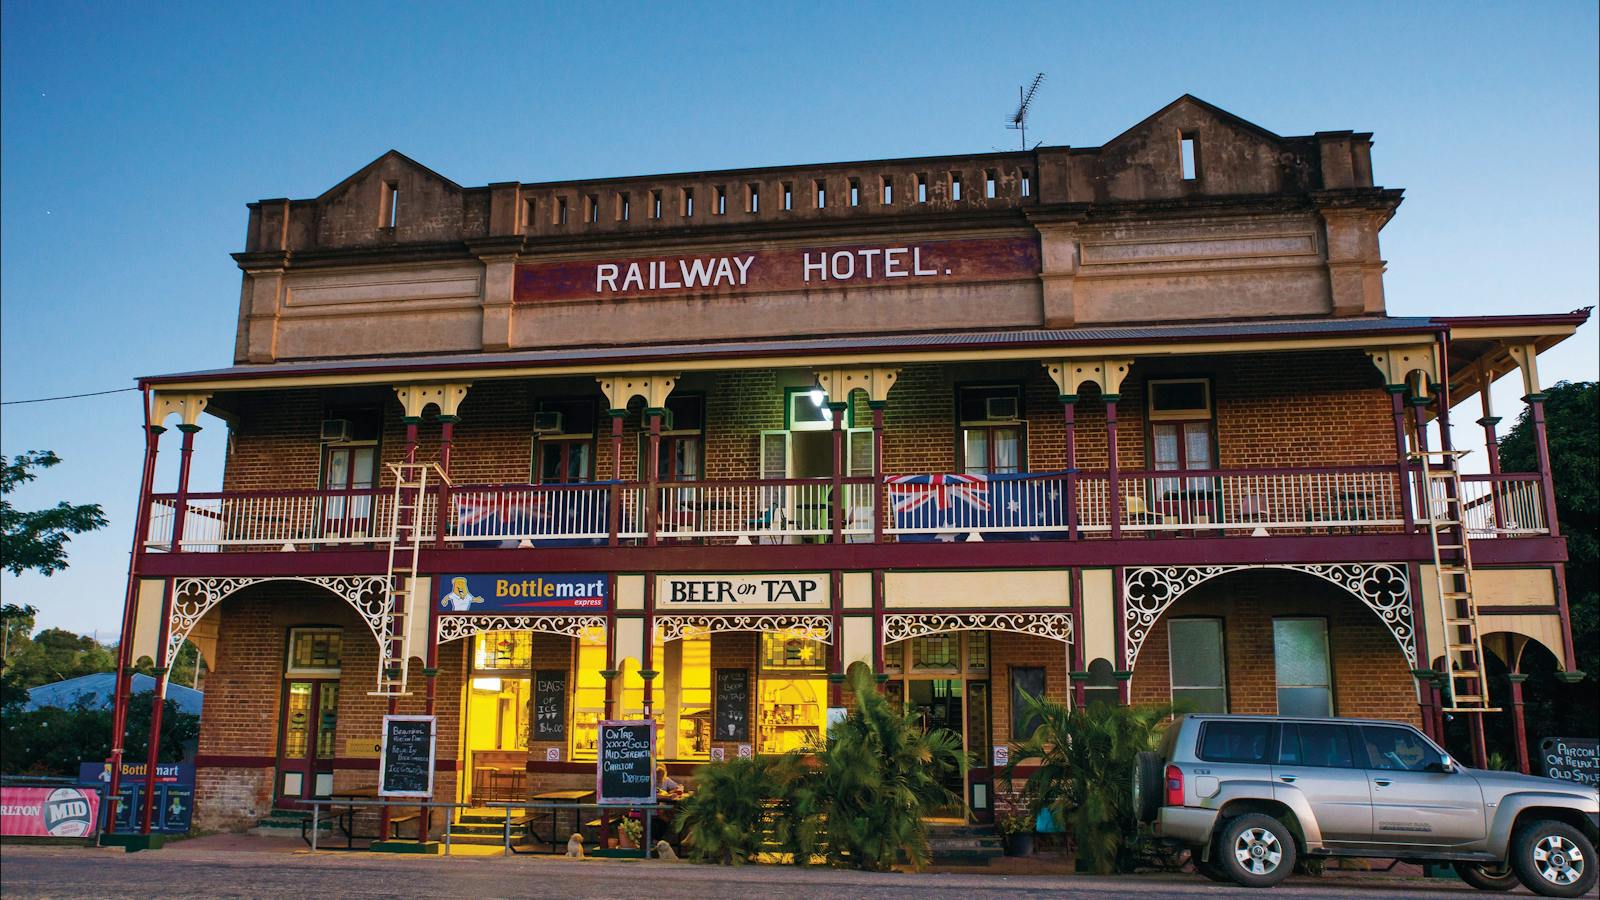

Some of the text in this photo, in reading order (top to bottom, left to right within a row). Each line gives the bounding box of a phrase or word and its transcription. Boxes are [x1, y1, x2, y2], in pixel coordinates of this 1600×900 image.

[596, 256, 755, 292] RAILWAY
[496, 577, 604, 597] Bottlemart
[670, 580, 817, 602] BEER on TAP
[574, 599, 602, 607] express
[538, 680, 565, 692] BAGS
[538, 704, 557, 713] ICE
[540, 722, 563, 733] $4.00
[605, 727, 633, 739] ON TAP
[605, 750, 620, 759] MID
[1547, 754, 1563, 765] OR
[122, 764, 179, 778] Bottlmart
[1550, 768, 1571, 779] OLD
[49, 800, 87, 824] MID
